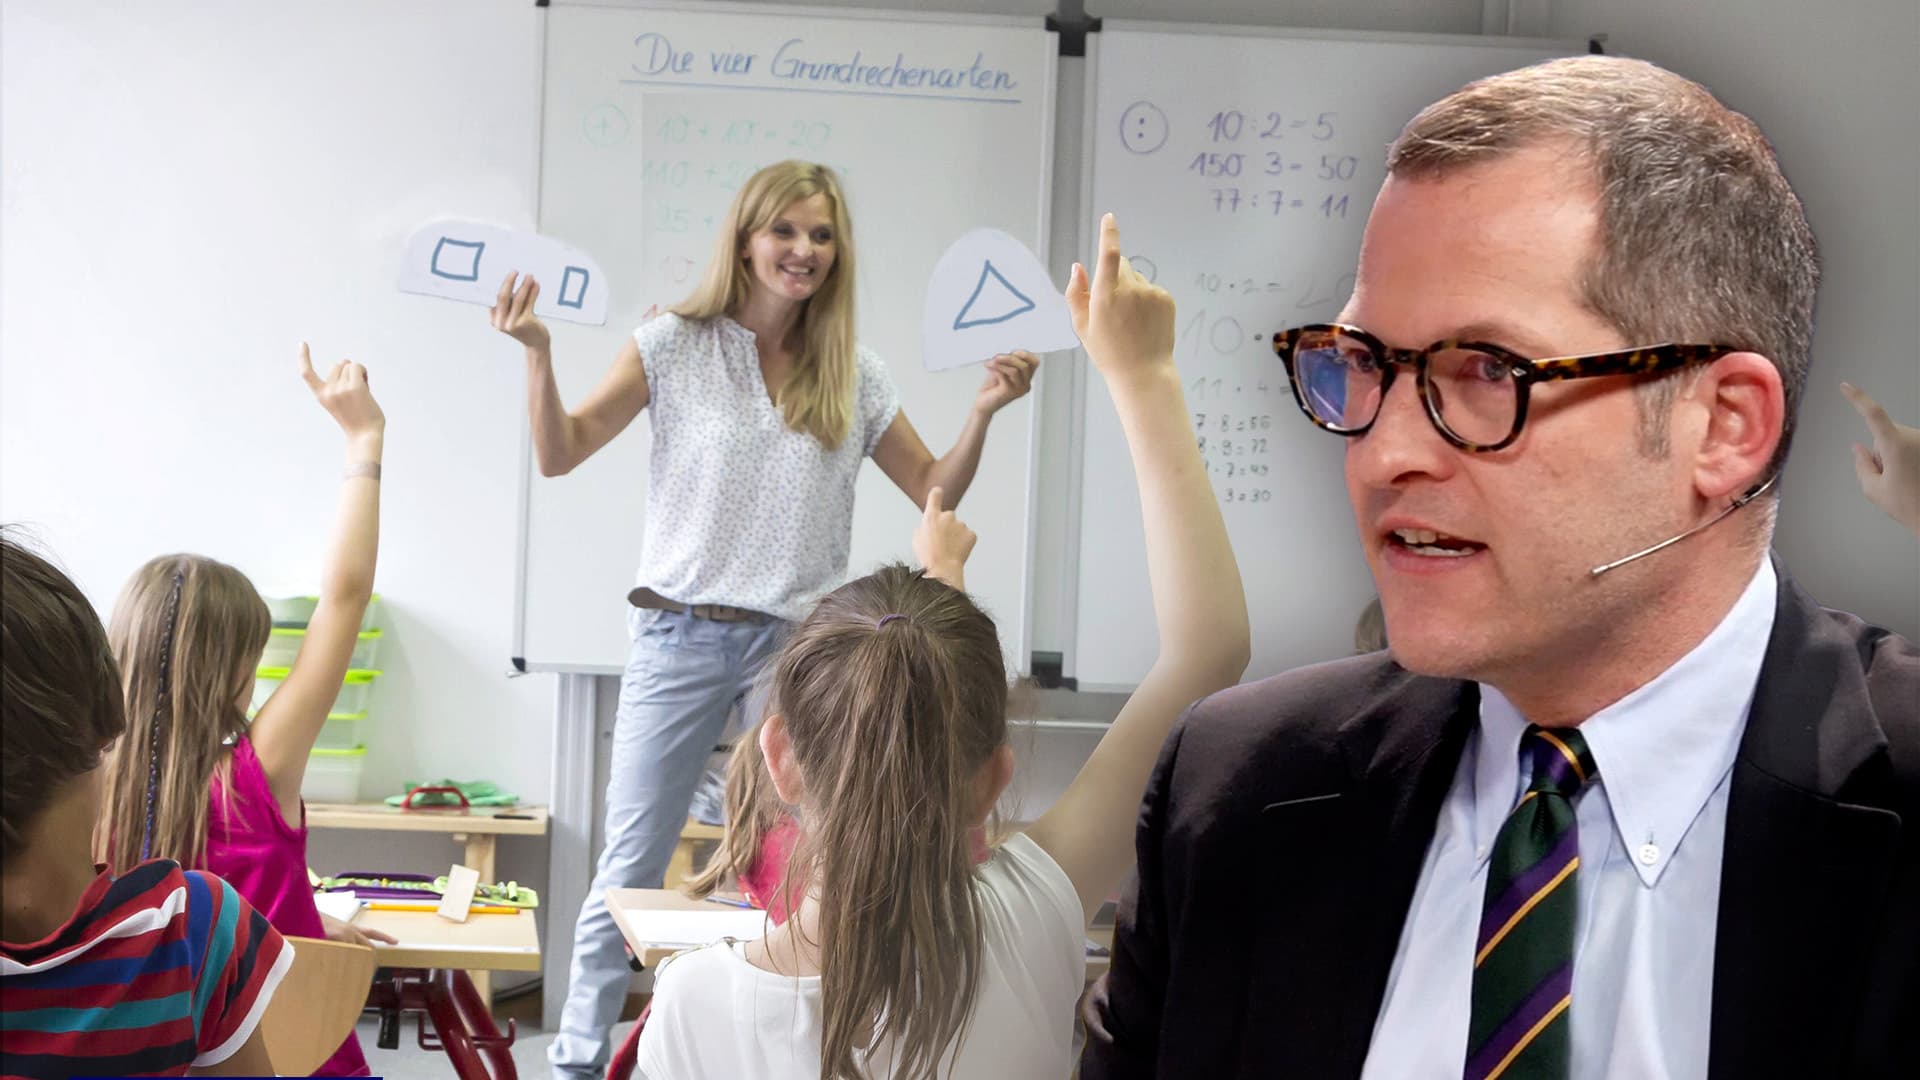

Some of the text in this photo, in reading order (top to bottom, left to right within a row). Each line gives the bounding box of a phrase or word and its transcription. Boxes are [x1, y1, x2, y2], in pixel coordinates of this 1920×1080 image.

[632, 33, 1020, 91] Die vier Grundrechenarten
[657, 114, 691, 144] 10
[723, 119, 758, 145] 10
[786, 119, 833, 150] 20
[1206, 110, 1246, 142] 10
[1259, 111, 1284, 139] 2
[1311, 111, 1339, 141] 5
[1188, 152, 1247, 177] 150
[1264, 151, 1283, 175] 3
[1317, 154, 1361, 181] 50
[1209, 187, 1242, 213] 77
[1267, 189, 1284, 216] 7
[1320, 193, 1349, 220] 11
[1194, 273, 1221, 293] 10
[1182, 308, 1245, 357] 10
[1249, 487, 1272, 503] 30
